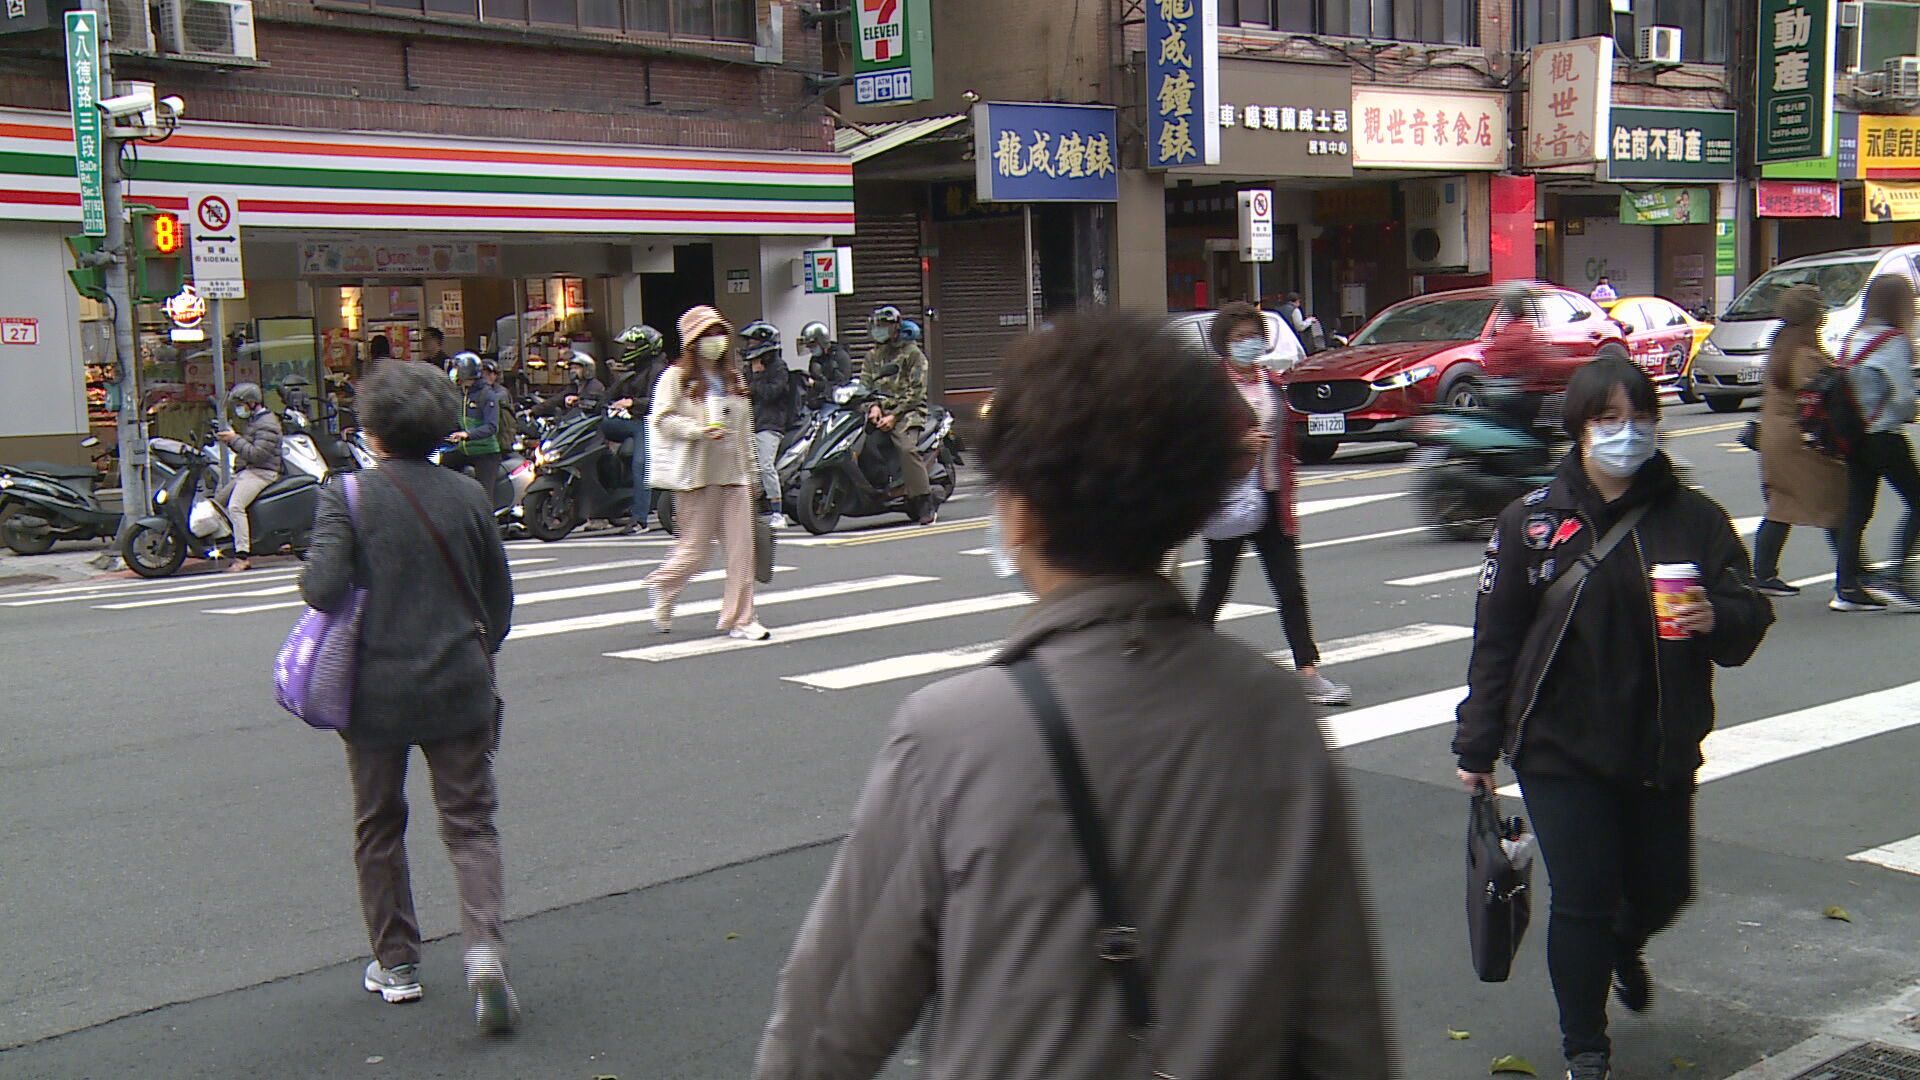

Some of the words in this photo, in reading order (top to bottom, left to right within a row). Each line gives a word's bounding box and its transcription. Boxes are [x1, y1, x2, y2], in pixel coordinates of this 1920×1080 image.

[1773, 0, 1812, 93] 動產
[75, 35, 96, 157] 八德路三段
[877, 77, 891, 86] ATM
[1545, 51, 1580, 157] 觀世音
[1364, 107, 1492, 146] 觀世音素食店
[1613, 126, 1702, 161] 住商不動產
[994, 130, 1115, 179] 龍成鐘錶
[155, 215, 175, 252] 8
[203, 256, 240, 264] SIDEWALK
[10, 327, 30, 341] 27
